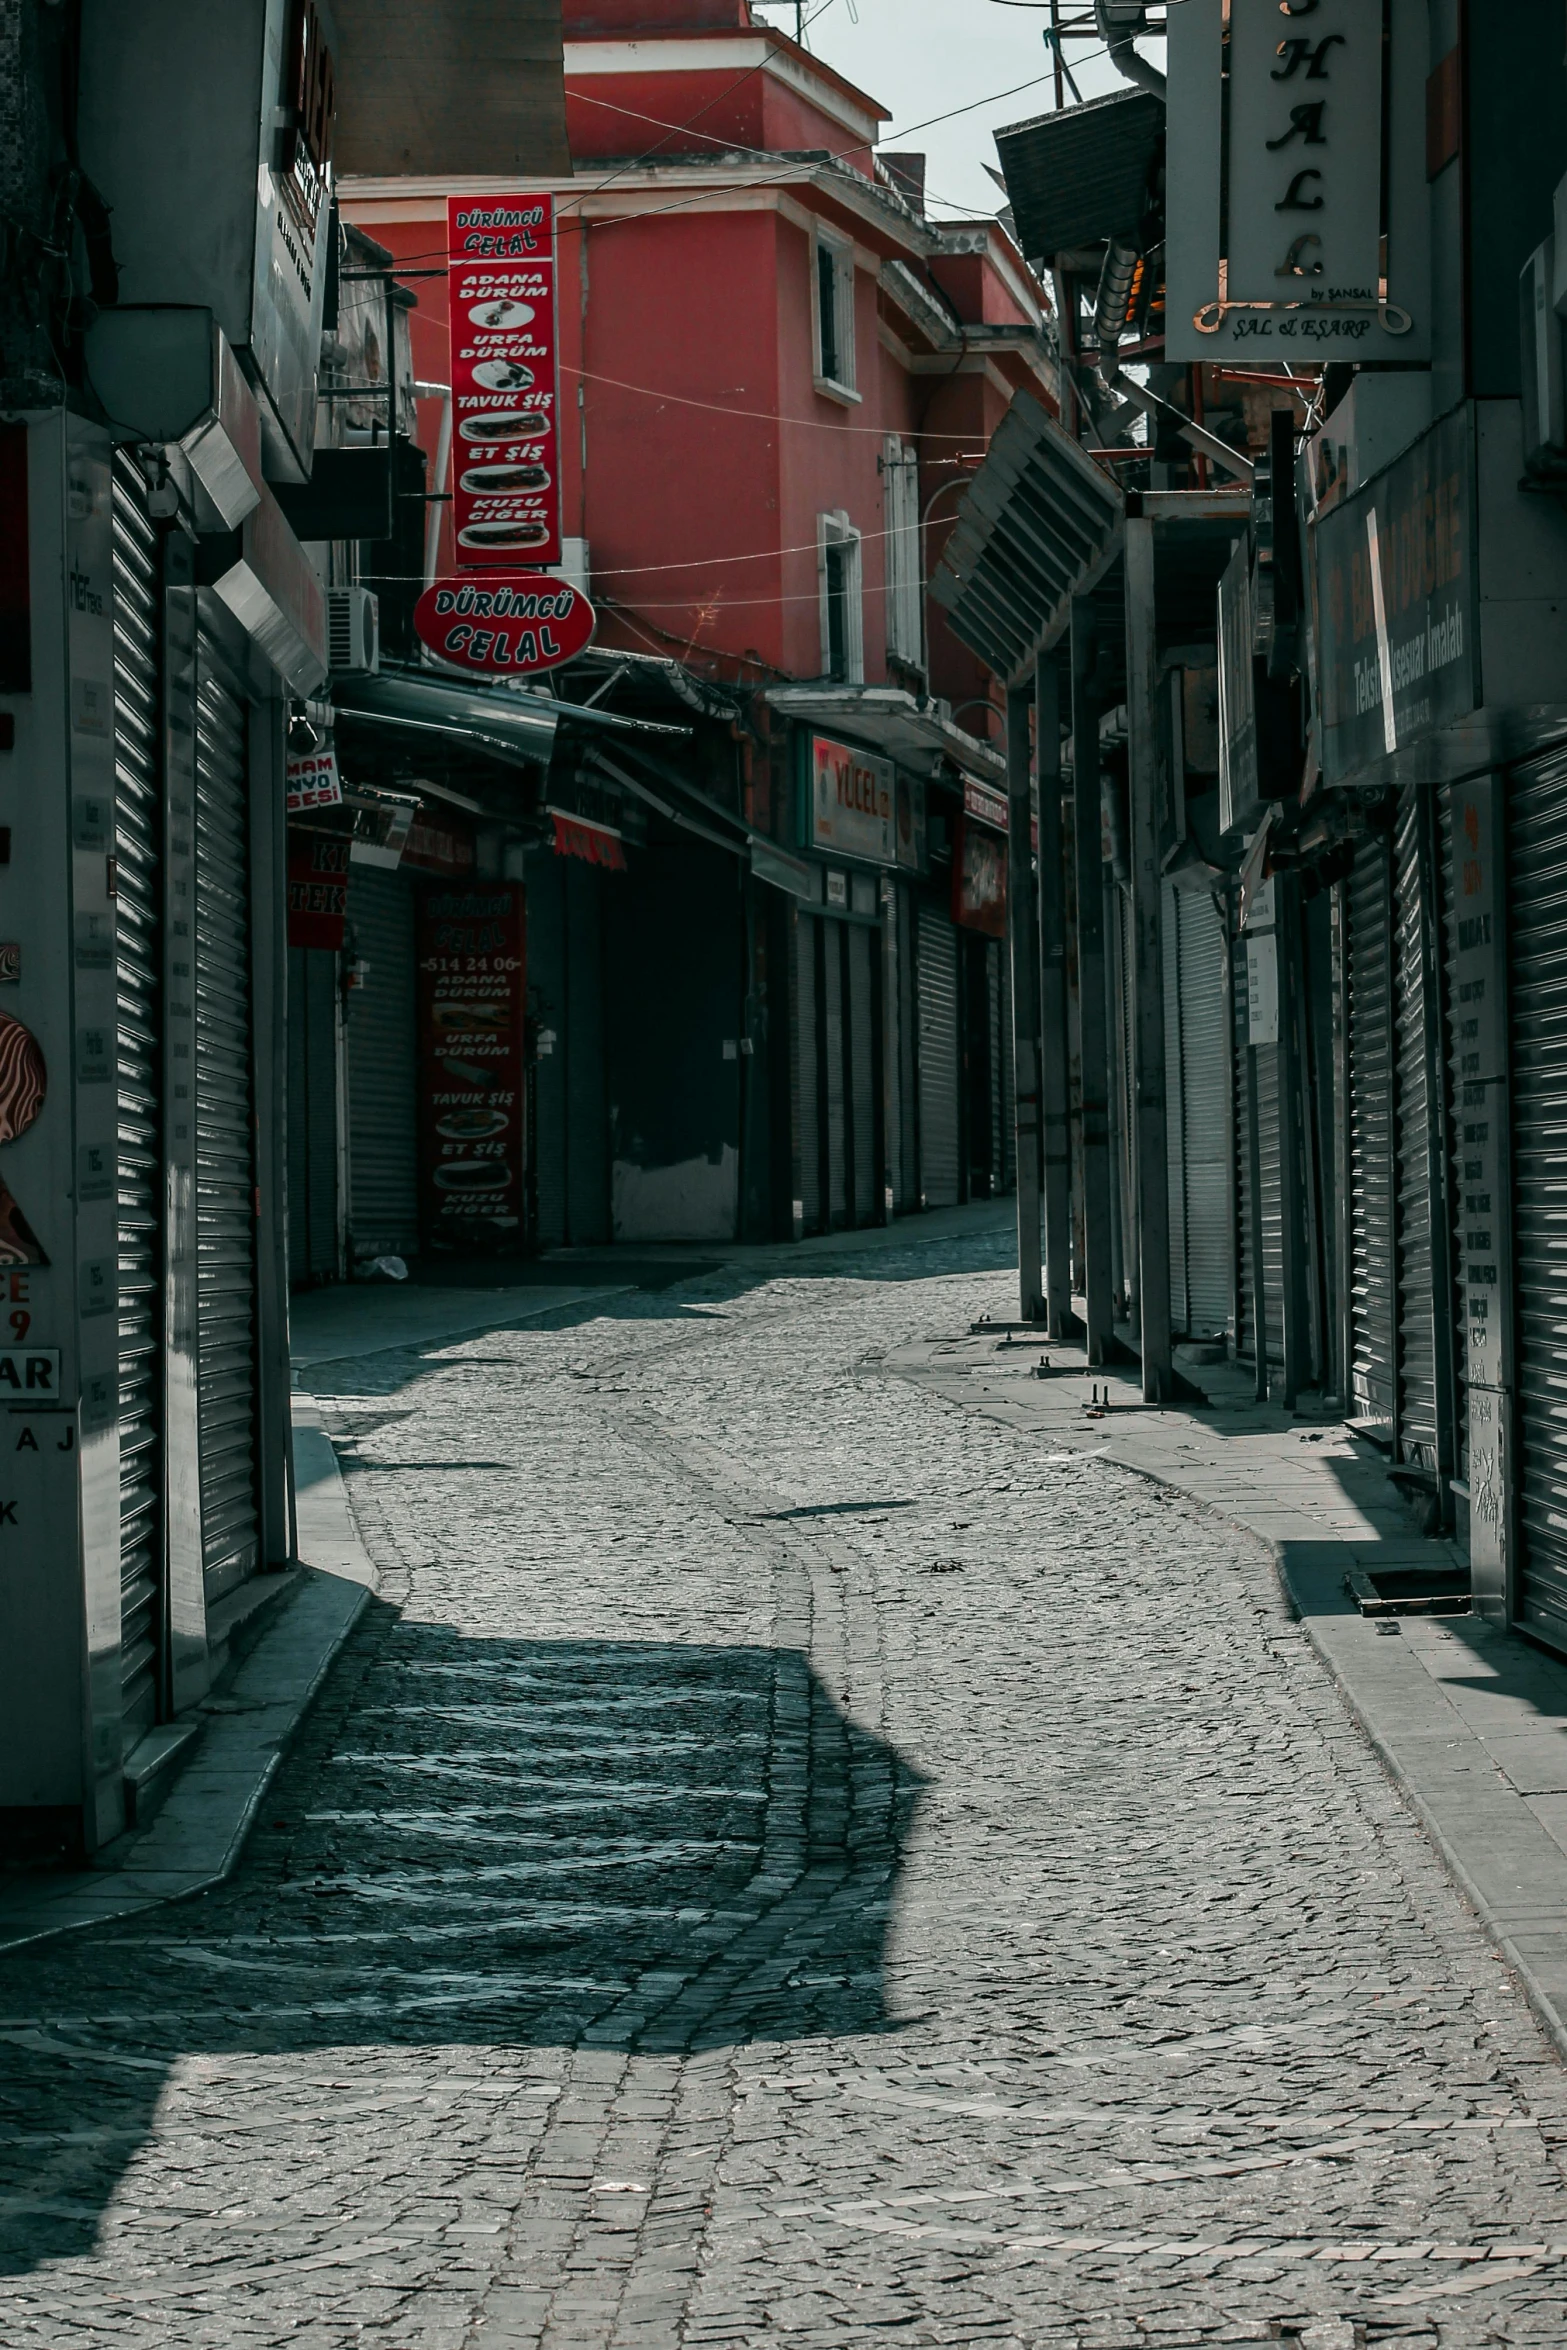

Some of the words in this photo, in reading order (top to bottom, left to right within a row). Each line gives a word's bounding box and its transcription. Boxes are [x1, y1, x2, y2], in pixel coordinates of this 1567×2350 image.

[456, 205, 544, 228] DÜRÜMCÜ
[464, 229, 538, 257] CELAL
[462, 273, 543, 286] ADANA
[458, 286, 548, 299] DÜRÜM
[1311, 287, 1324, 301] by
[1328, 287, 1373, 301] ŞANSAL
[1232, 318, 1273, 341] ŞAL
[1278, 321, 1297, 337] &
[1300, 318, 1371, 342] EŞARP
[472, 333, 534, 345] URFA
[459, 345, 548, 359] DÜRÜM
[457, 394, 519, 409] TAVUK
[522, 390, 554, 410] ŞİŞ
[468, 446, 500, 460] ET
[505, 442, 546, 462] ŞİŞ
[472, 497, 544, 509] KUZU
[467, 508, 549, 521] CİĞER
[434, 585, 575, 621] DÜRÜMCÜ
[444, 623, 562, 665] CELAL
[1384, 633, 1426, 698] Aksesuar
[1426, 600, 1463, 672] İmalatı
[427, 893, 513, 919] DÜRÜMCÜ
[434, 922, 506, 955] CELAL
[466, 957, 488, 972] 24
[437, 975, 507, 985] ADANA
[434, 986, 512, 998] DÜRÜM
[445, 1033, 498, 1044] URFA
[433, 1045, 511, 1057] DÜRÜM
[432, 1092, 485, 1106] TAVUK
[487, 1089, 515, 1107] ŞİŞ
[441, 1143, 469, 1156] ET
[472, 1140, 508, 1158] ŞİŞ
[444, 1193, 506, 1203] KUZU
[440, 1203, 510, 1215] CİĞER
